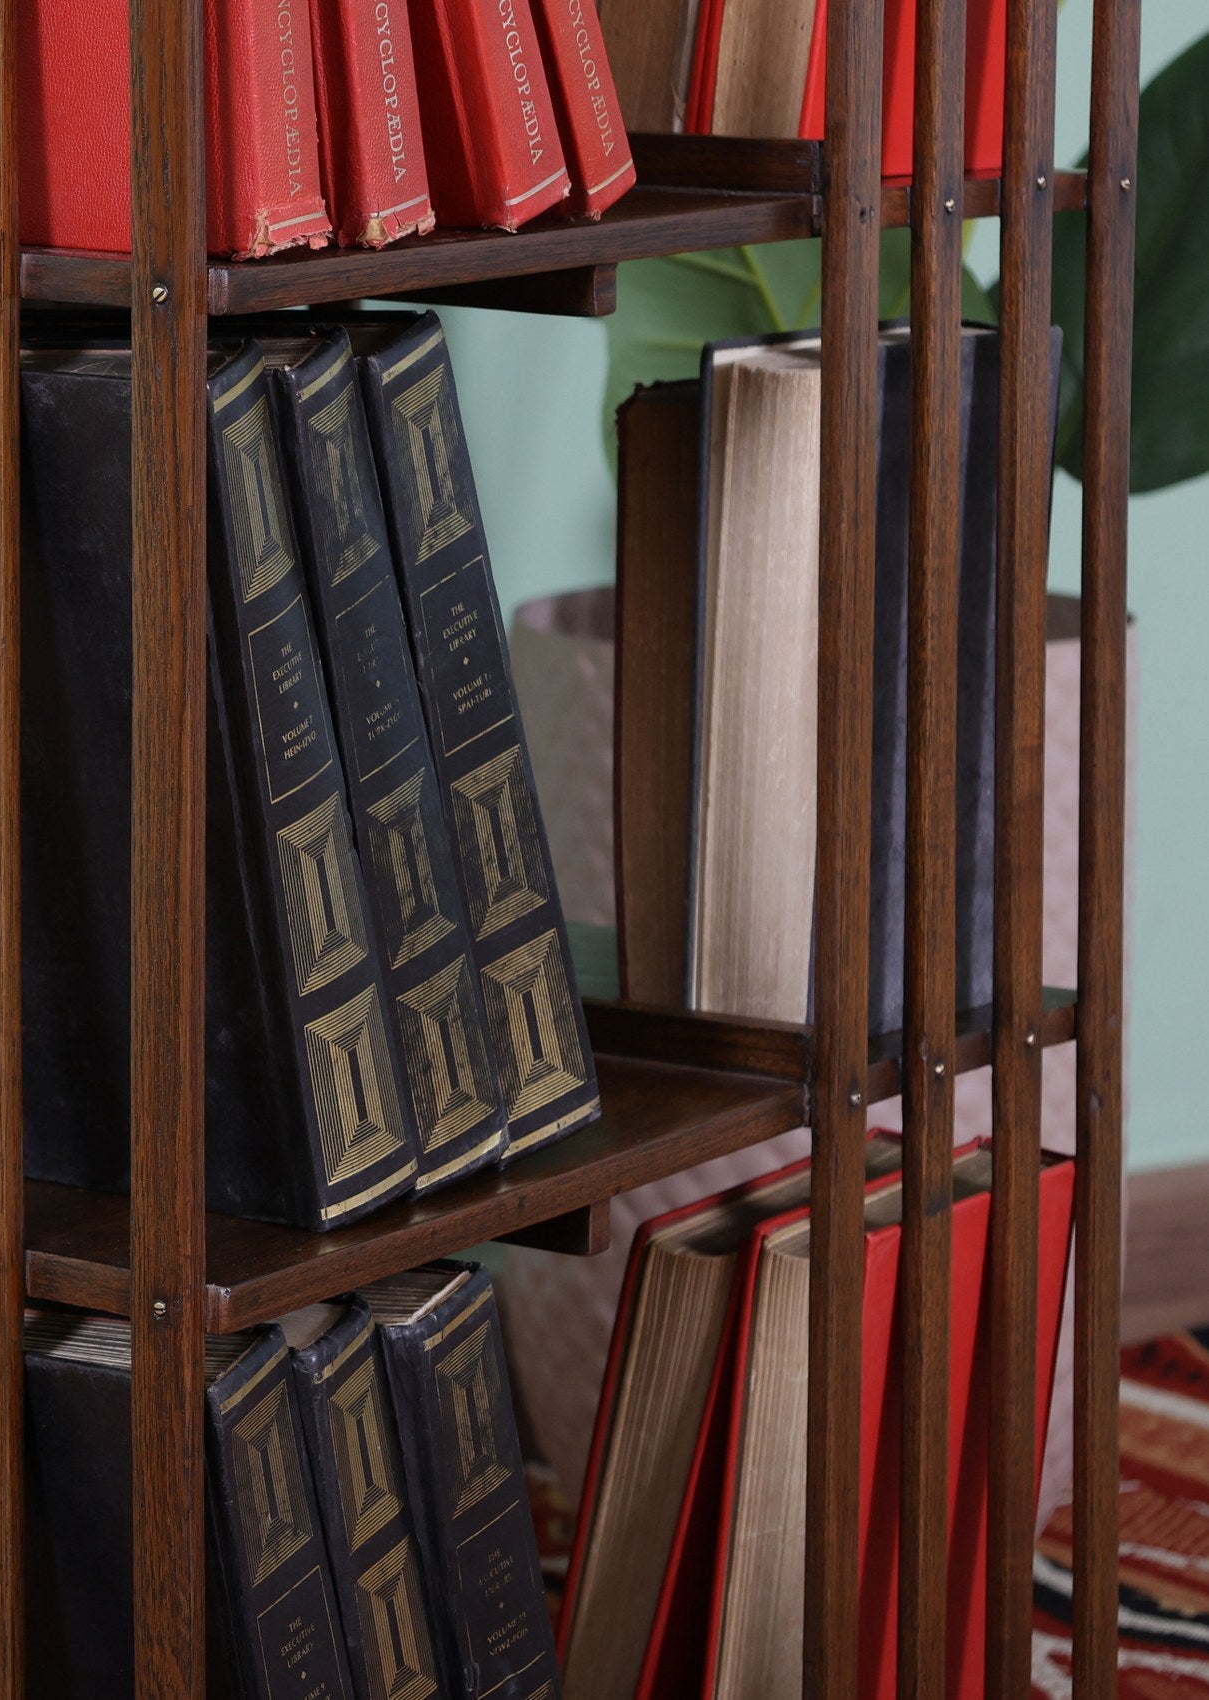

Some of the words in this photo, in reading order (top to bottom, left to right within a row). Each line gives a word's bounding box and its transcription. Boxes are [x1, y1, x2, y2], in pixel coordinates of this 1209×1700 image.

[451, 602, 465, 617] THE
[442, 609, 479, 640] EXECUTIVE
[280, 641, 294, 658] THE
[448, 627, 478, 652] LIBRARY
[272, 651, 304, 682] EXECUTIVE
[278, 670, 304, 695] LIBRARY
[452, 676, 484, 701] VOLUME
[288, 1616, 302, 1632] THE
[280, 1623, 317, 1657] EXECUTIVE
